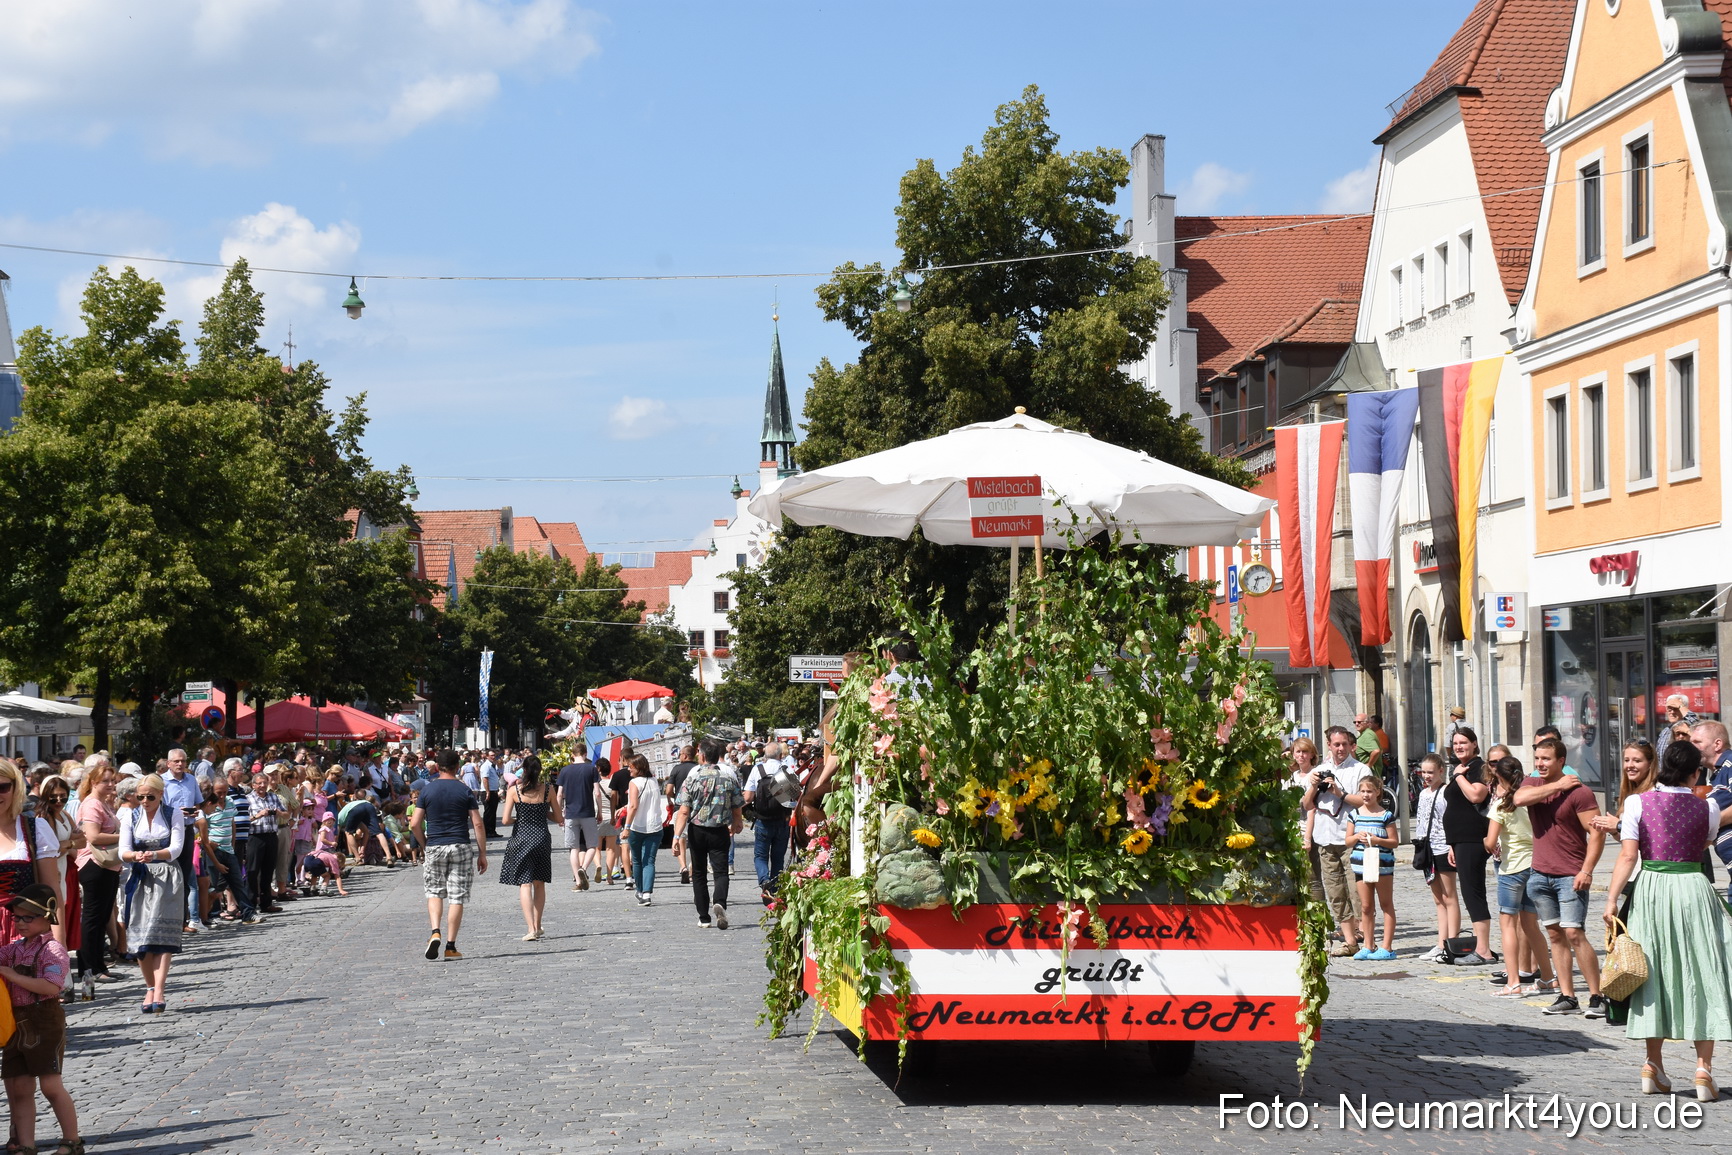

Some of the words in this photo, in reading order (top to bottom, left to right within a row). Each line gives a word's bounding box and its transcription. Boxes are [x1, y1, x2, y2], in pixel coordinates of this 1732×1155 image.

[974, 479, 1035, 495] Mistelbach
[987, 498, 1019, 515] grüßt
[978, 518, 1032, 533] Neumarkt
[1229, 570, 1236, 599] P
[1497, 596, 1514, 612] EC
[800, 658, 843, 667] Parkleitsystem
[985, 915, 1198, 947] Miselbach
[1034, 957, 1145, 994] grüßt
[906, 1000, 1111, 1033] Neumarkt
